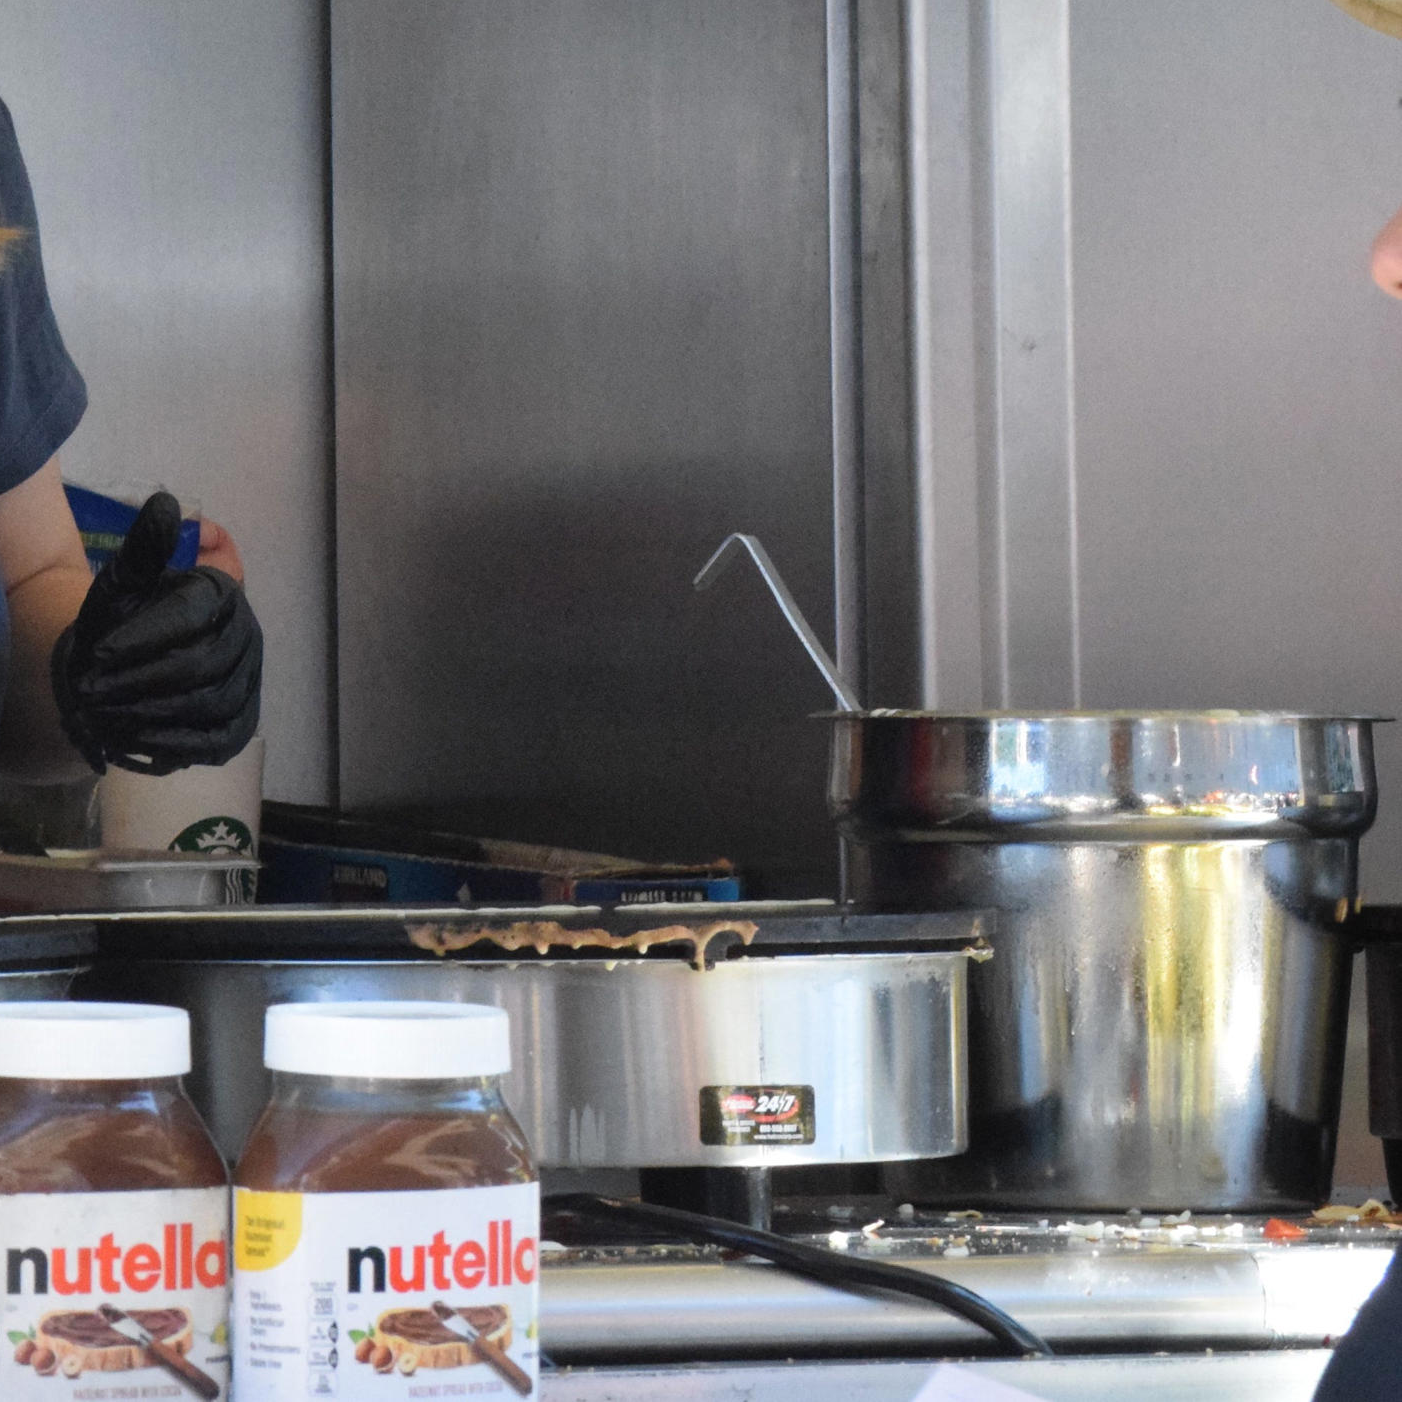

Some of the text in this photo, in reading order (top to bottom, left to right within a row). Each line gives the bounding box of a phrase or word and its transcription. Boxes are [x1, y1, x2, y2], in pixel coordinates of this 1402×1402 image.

[754, 1090, 797, 1115] 24/7
[6, 1222, 227, 1296] nutella
[347, 1218, 537, 1294] nutella
